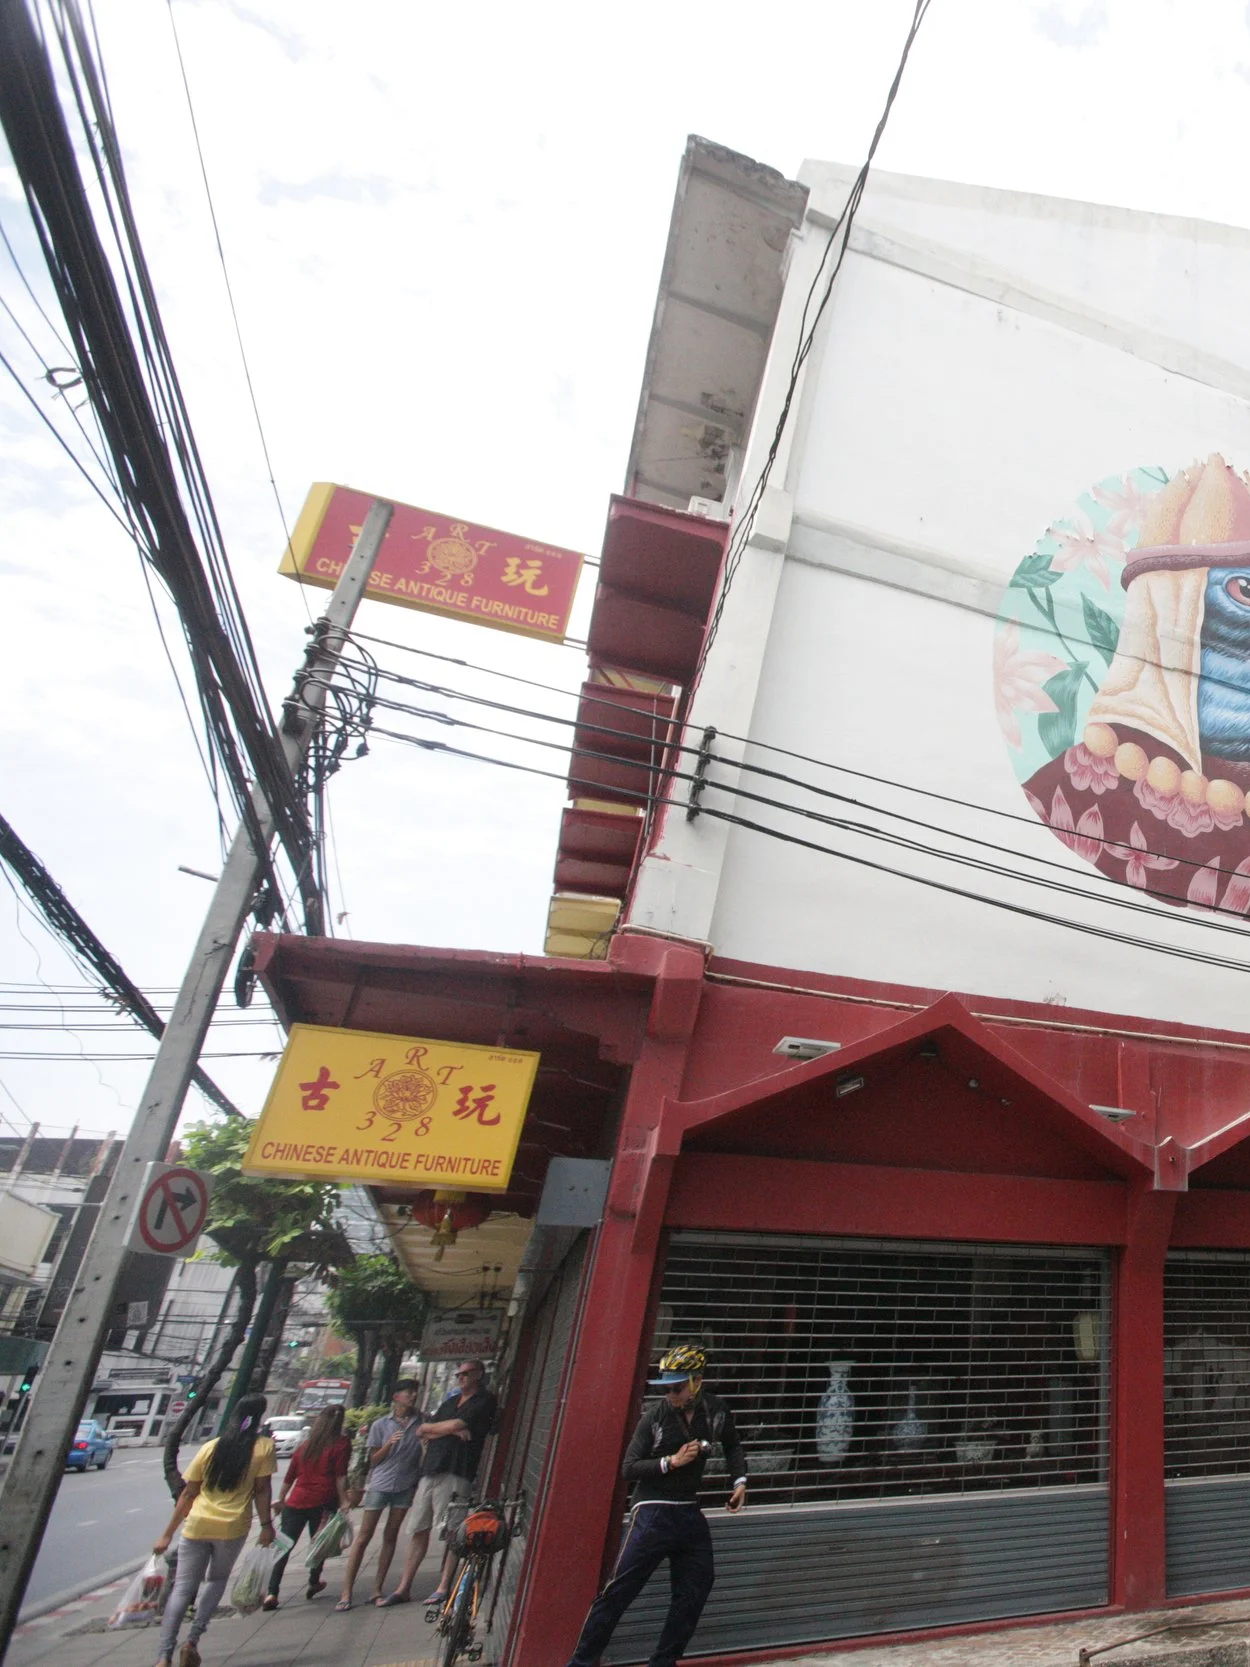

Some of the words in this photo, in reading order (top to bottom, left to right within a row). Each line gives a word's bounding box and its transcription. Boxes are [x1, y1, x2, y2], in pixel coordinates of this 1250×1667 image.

[411, 523, 497, 556] ART
[415, 561, 475, 587] 328
[500, 557, 549, 596] 玩
[316, 557, 393, 588] CHSE
[394, 578, 467, 607] ANTIQUE
[471, 598, 560, 629] FURNITURE
[353, 1046, 464, 1087] ART
[298, 1066, 341, 1111] 古
[452, 1084, 501, 1126] 玩
[356, 1111, 433, 1142] 328
[261, 1142, 338, 1165] CHINESE
[339, 1148, 412, 1170] ANTIQUE
[413, 1153, 502, 1177] FURNITURE
